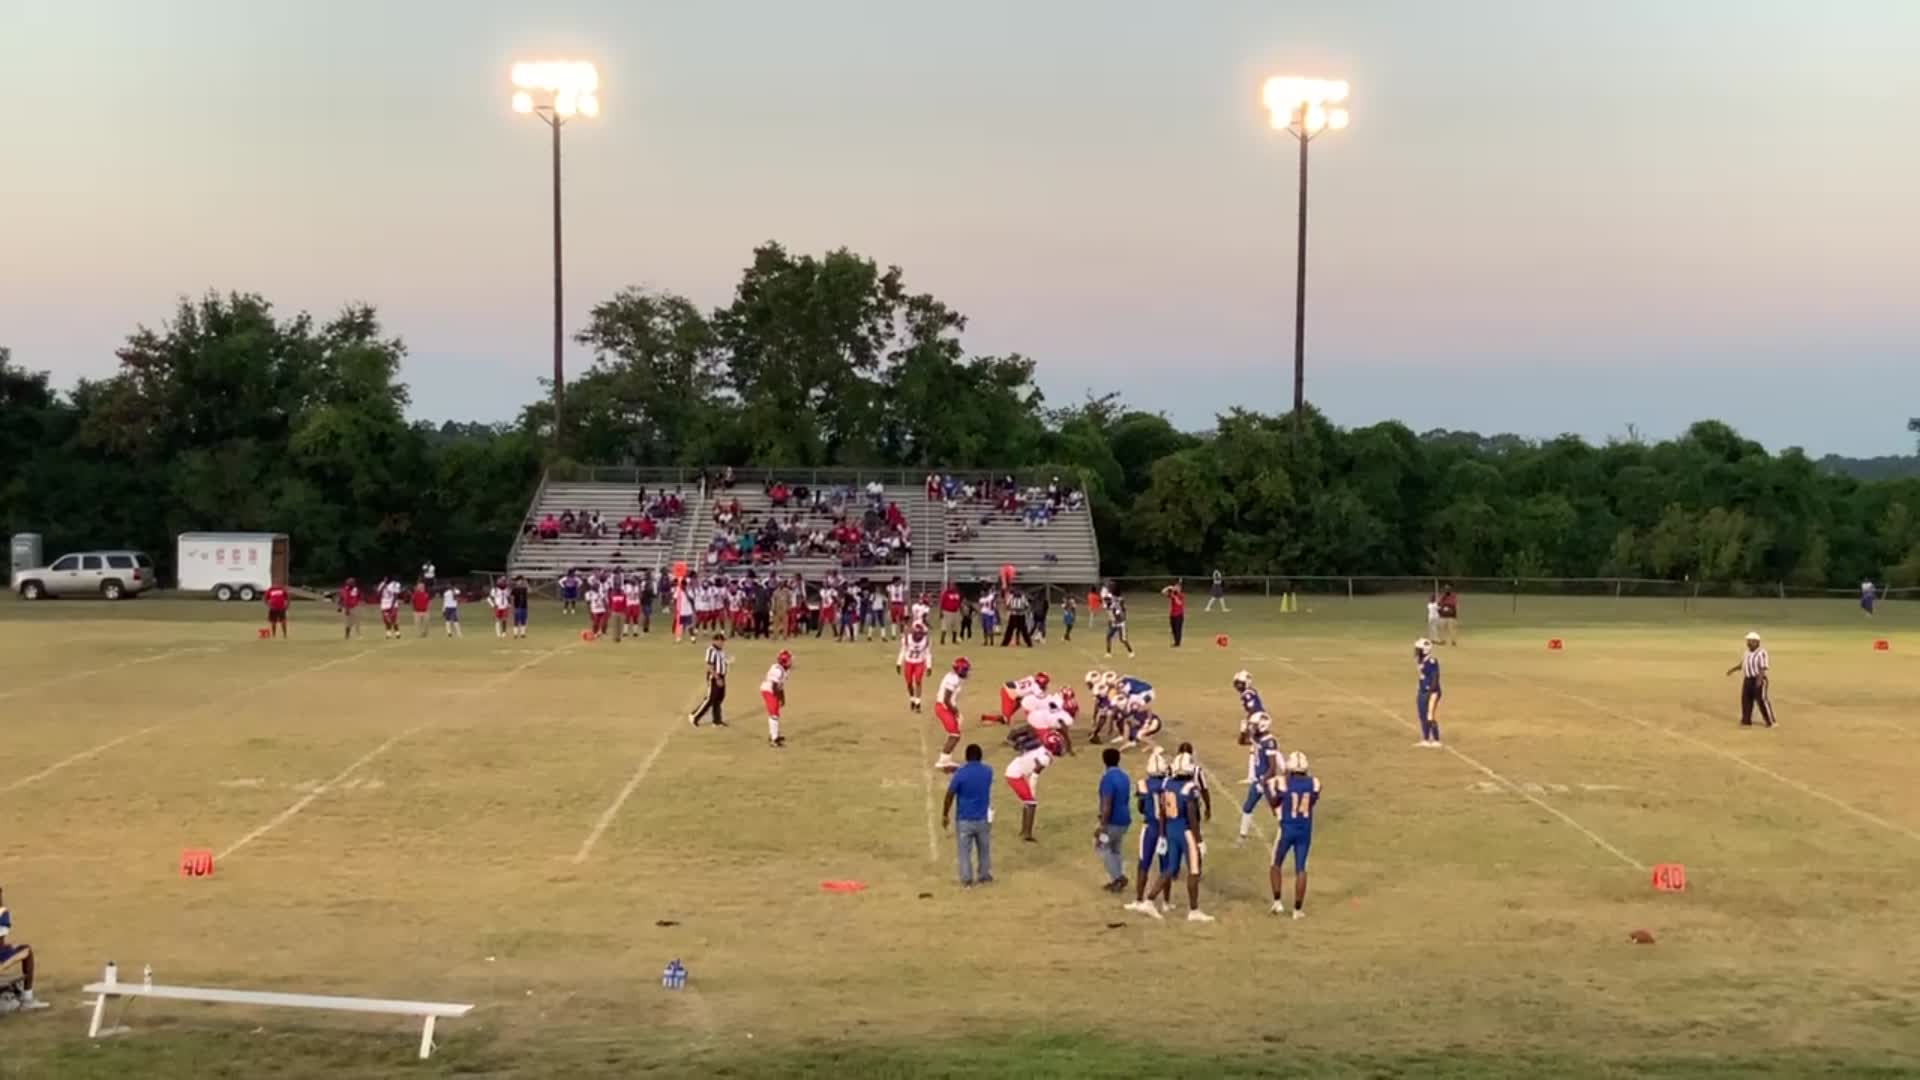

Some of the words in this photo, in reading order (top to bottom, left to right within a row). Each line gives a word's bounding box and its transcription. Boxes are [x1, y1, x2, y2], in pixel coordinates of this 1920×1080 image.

[1291, 791, 1310, 818] 14
[183, 856, 206, 877] 40
[1660, 867, 1682, 889] 40
